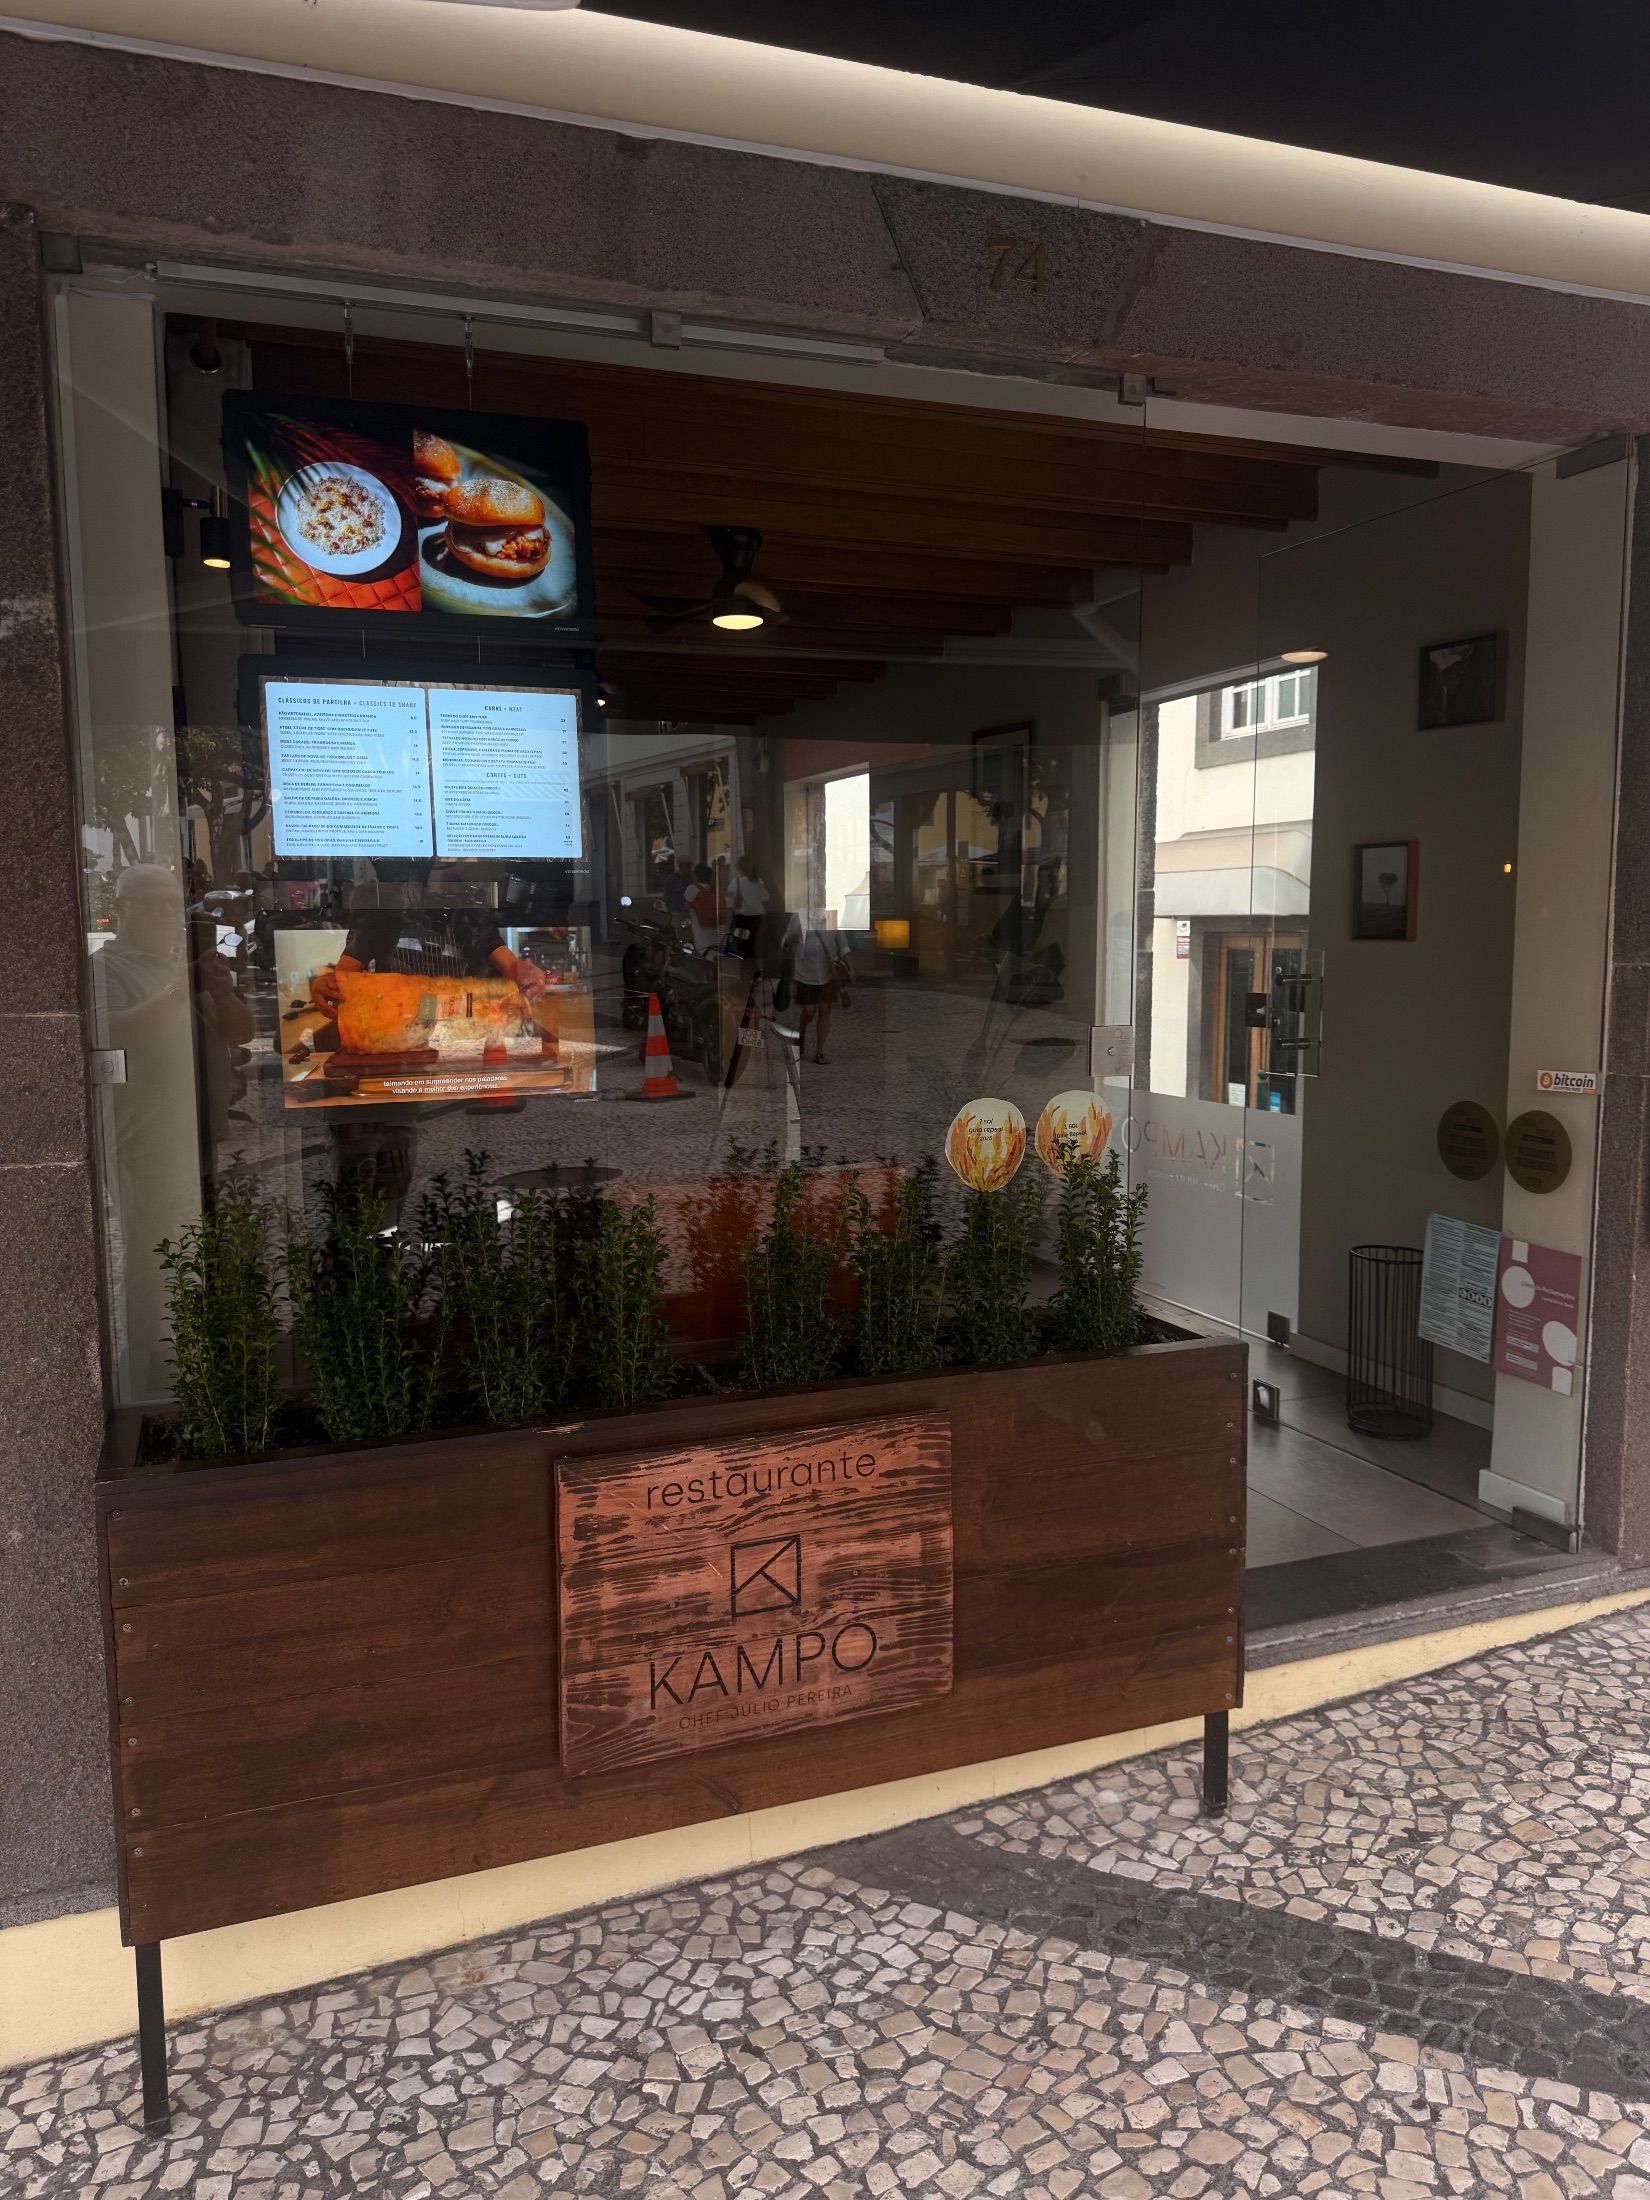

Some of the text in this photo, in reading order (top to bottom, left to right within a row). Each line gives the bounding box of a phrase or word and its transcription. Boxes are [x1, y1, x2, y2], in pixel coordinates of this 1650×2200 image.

[988, 241, 1050, 296] 74
[278, 696, 311, 705] CLÁSSICOS
[322, 698, 352, 706] PARTILHA
[359, 700, 387, 708] CLASSICS
[1553, 1073, 1594, 1088] bitcoin
[647, 1451, 877, 1510] restaurante
[650, 1622, 878, 1711] KAMPO
[679, 1708, 722, 1730] CHEF
[787, 1680, 853, 1707] PEREIRA
